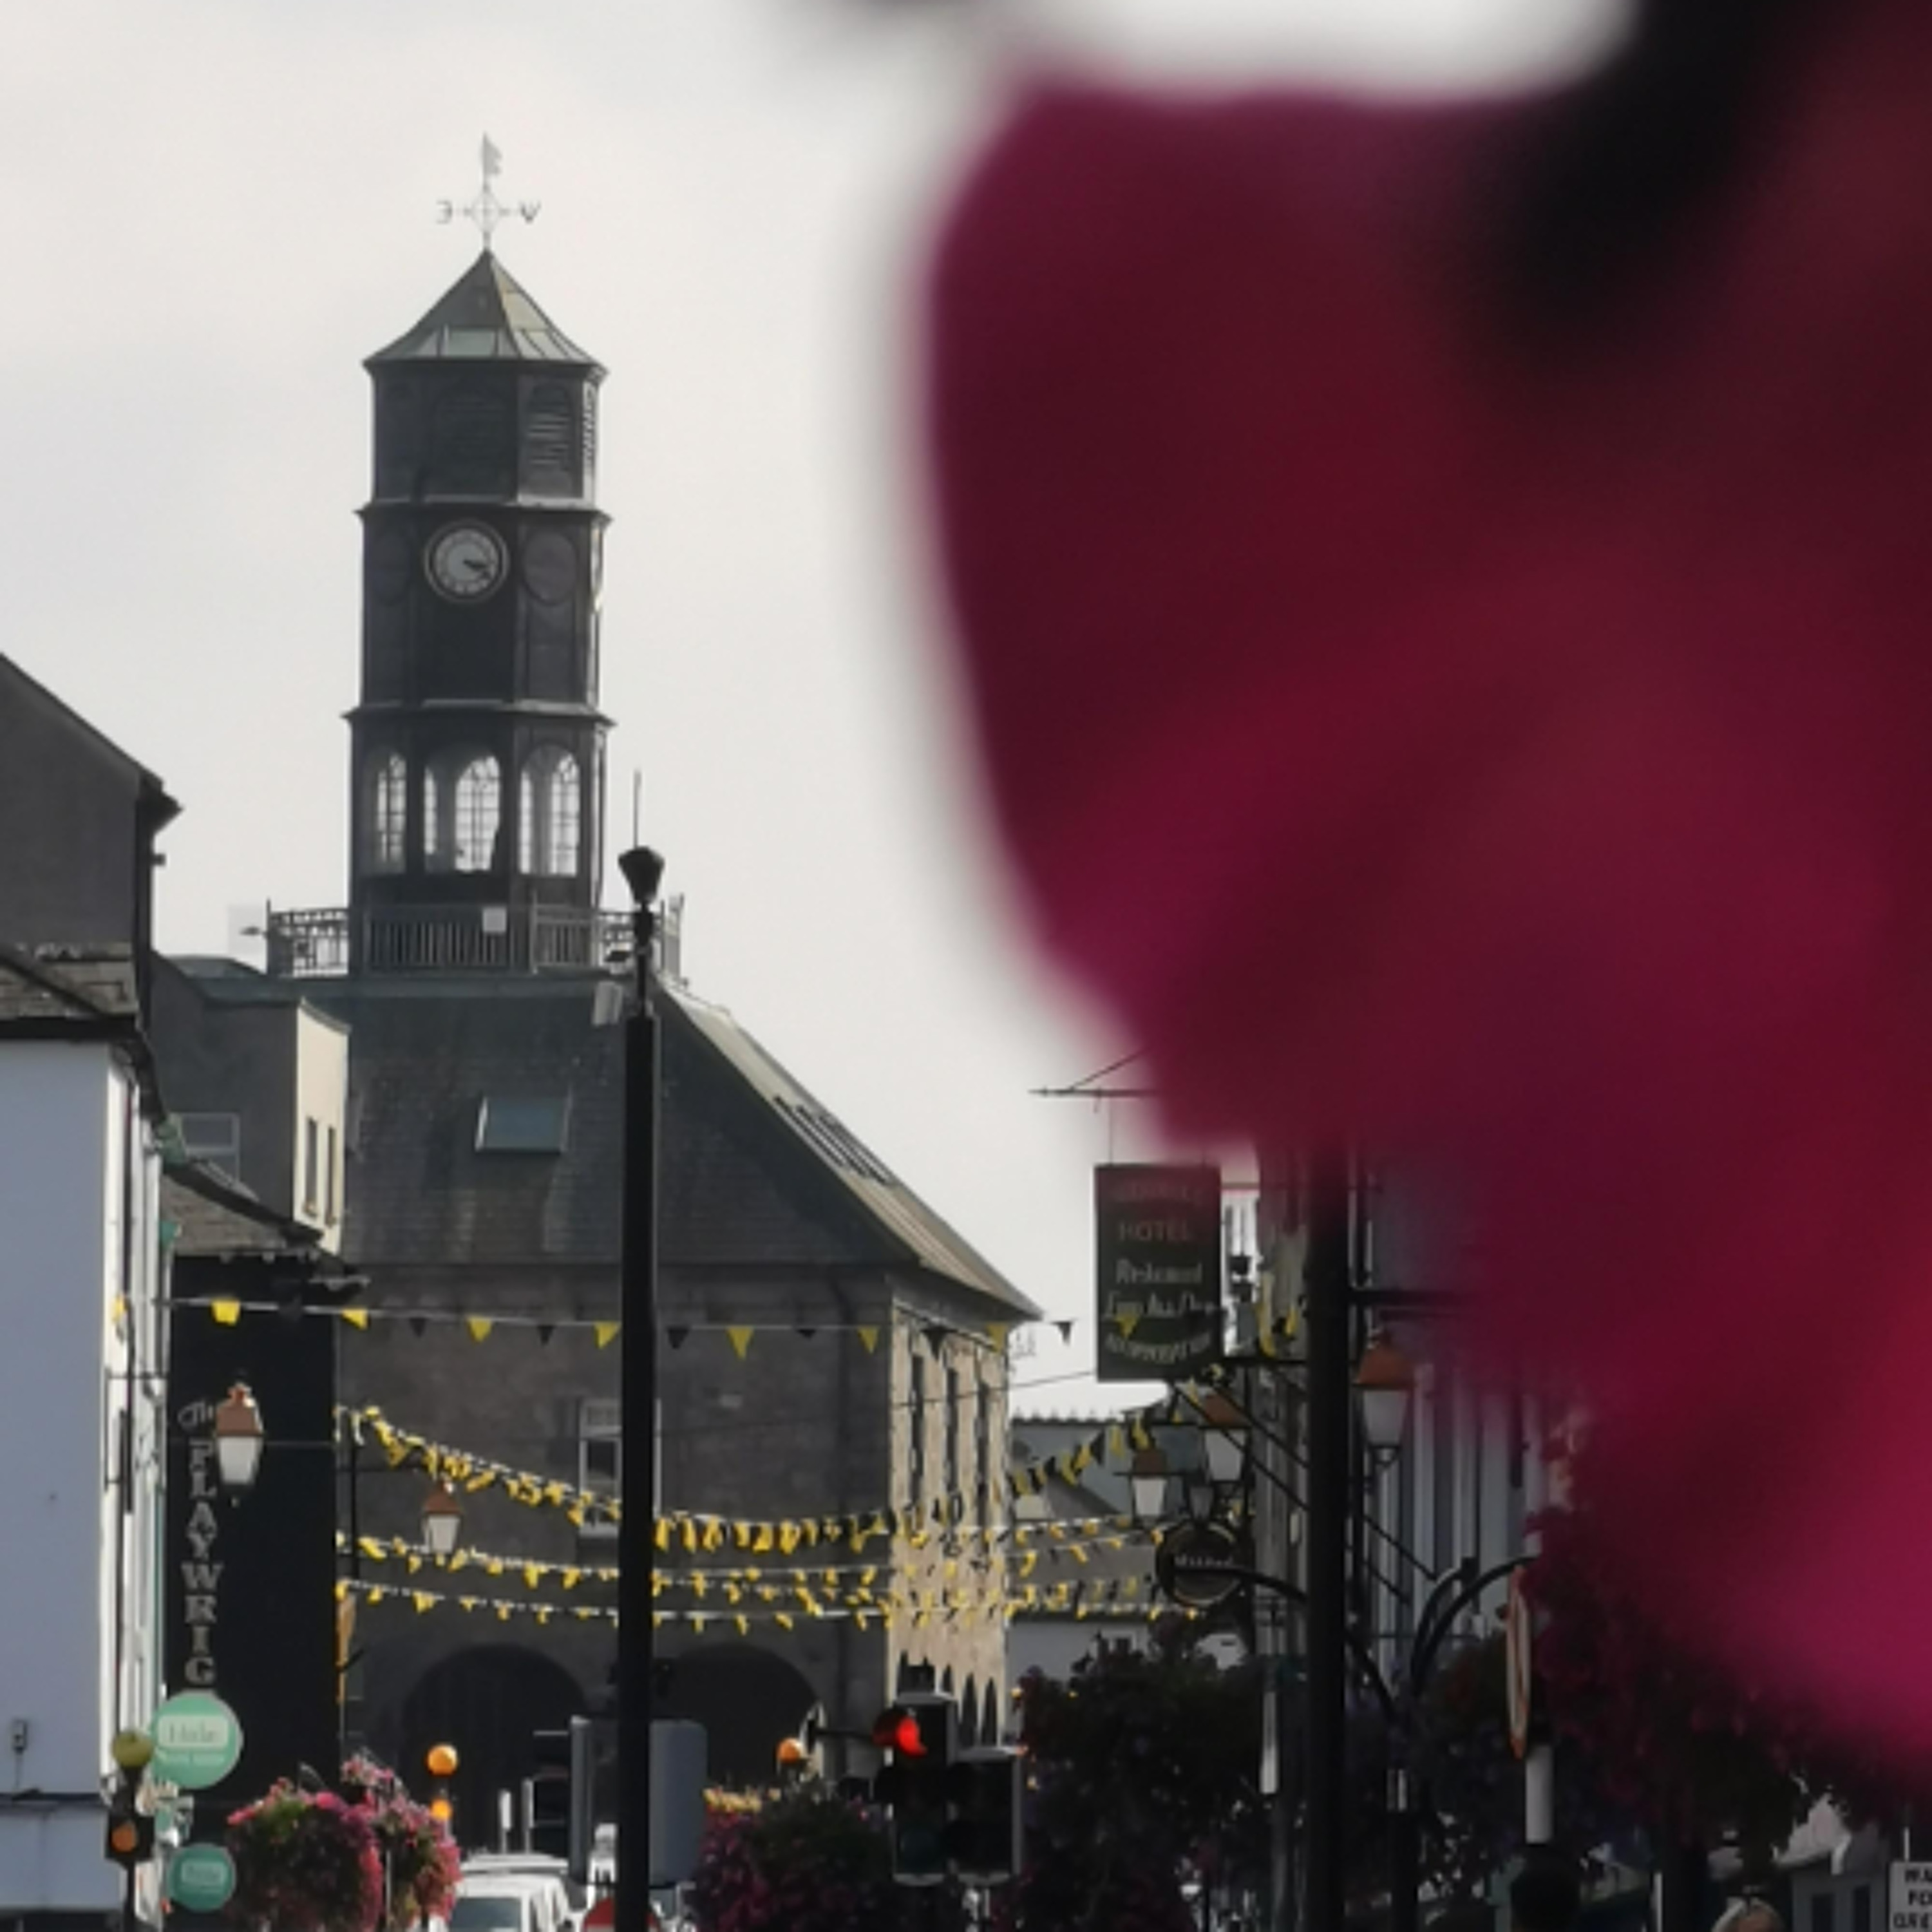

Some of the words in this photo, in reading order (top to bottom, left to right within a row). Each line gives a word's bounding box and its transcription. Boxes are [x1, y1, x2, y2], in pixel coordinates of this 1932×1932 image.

[1119, 1221, 1193, 1241] HOTEL
[178, 1401, 214, 1429] Th
[182, 1441, 223, 1685] PLAYWRIG
